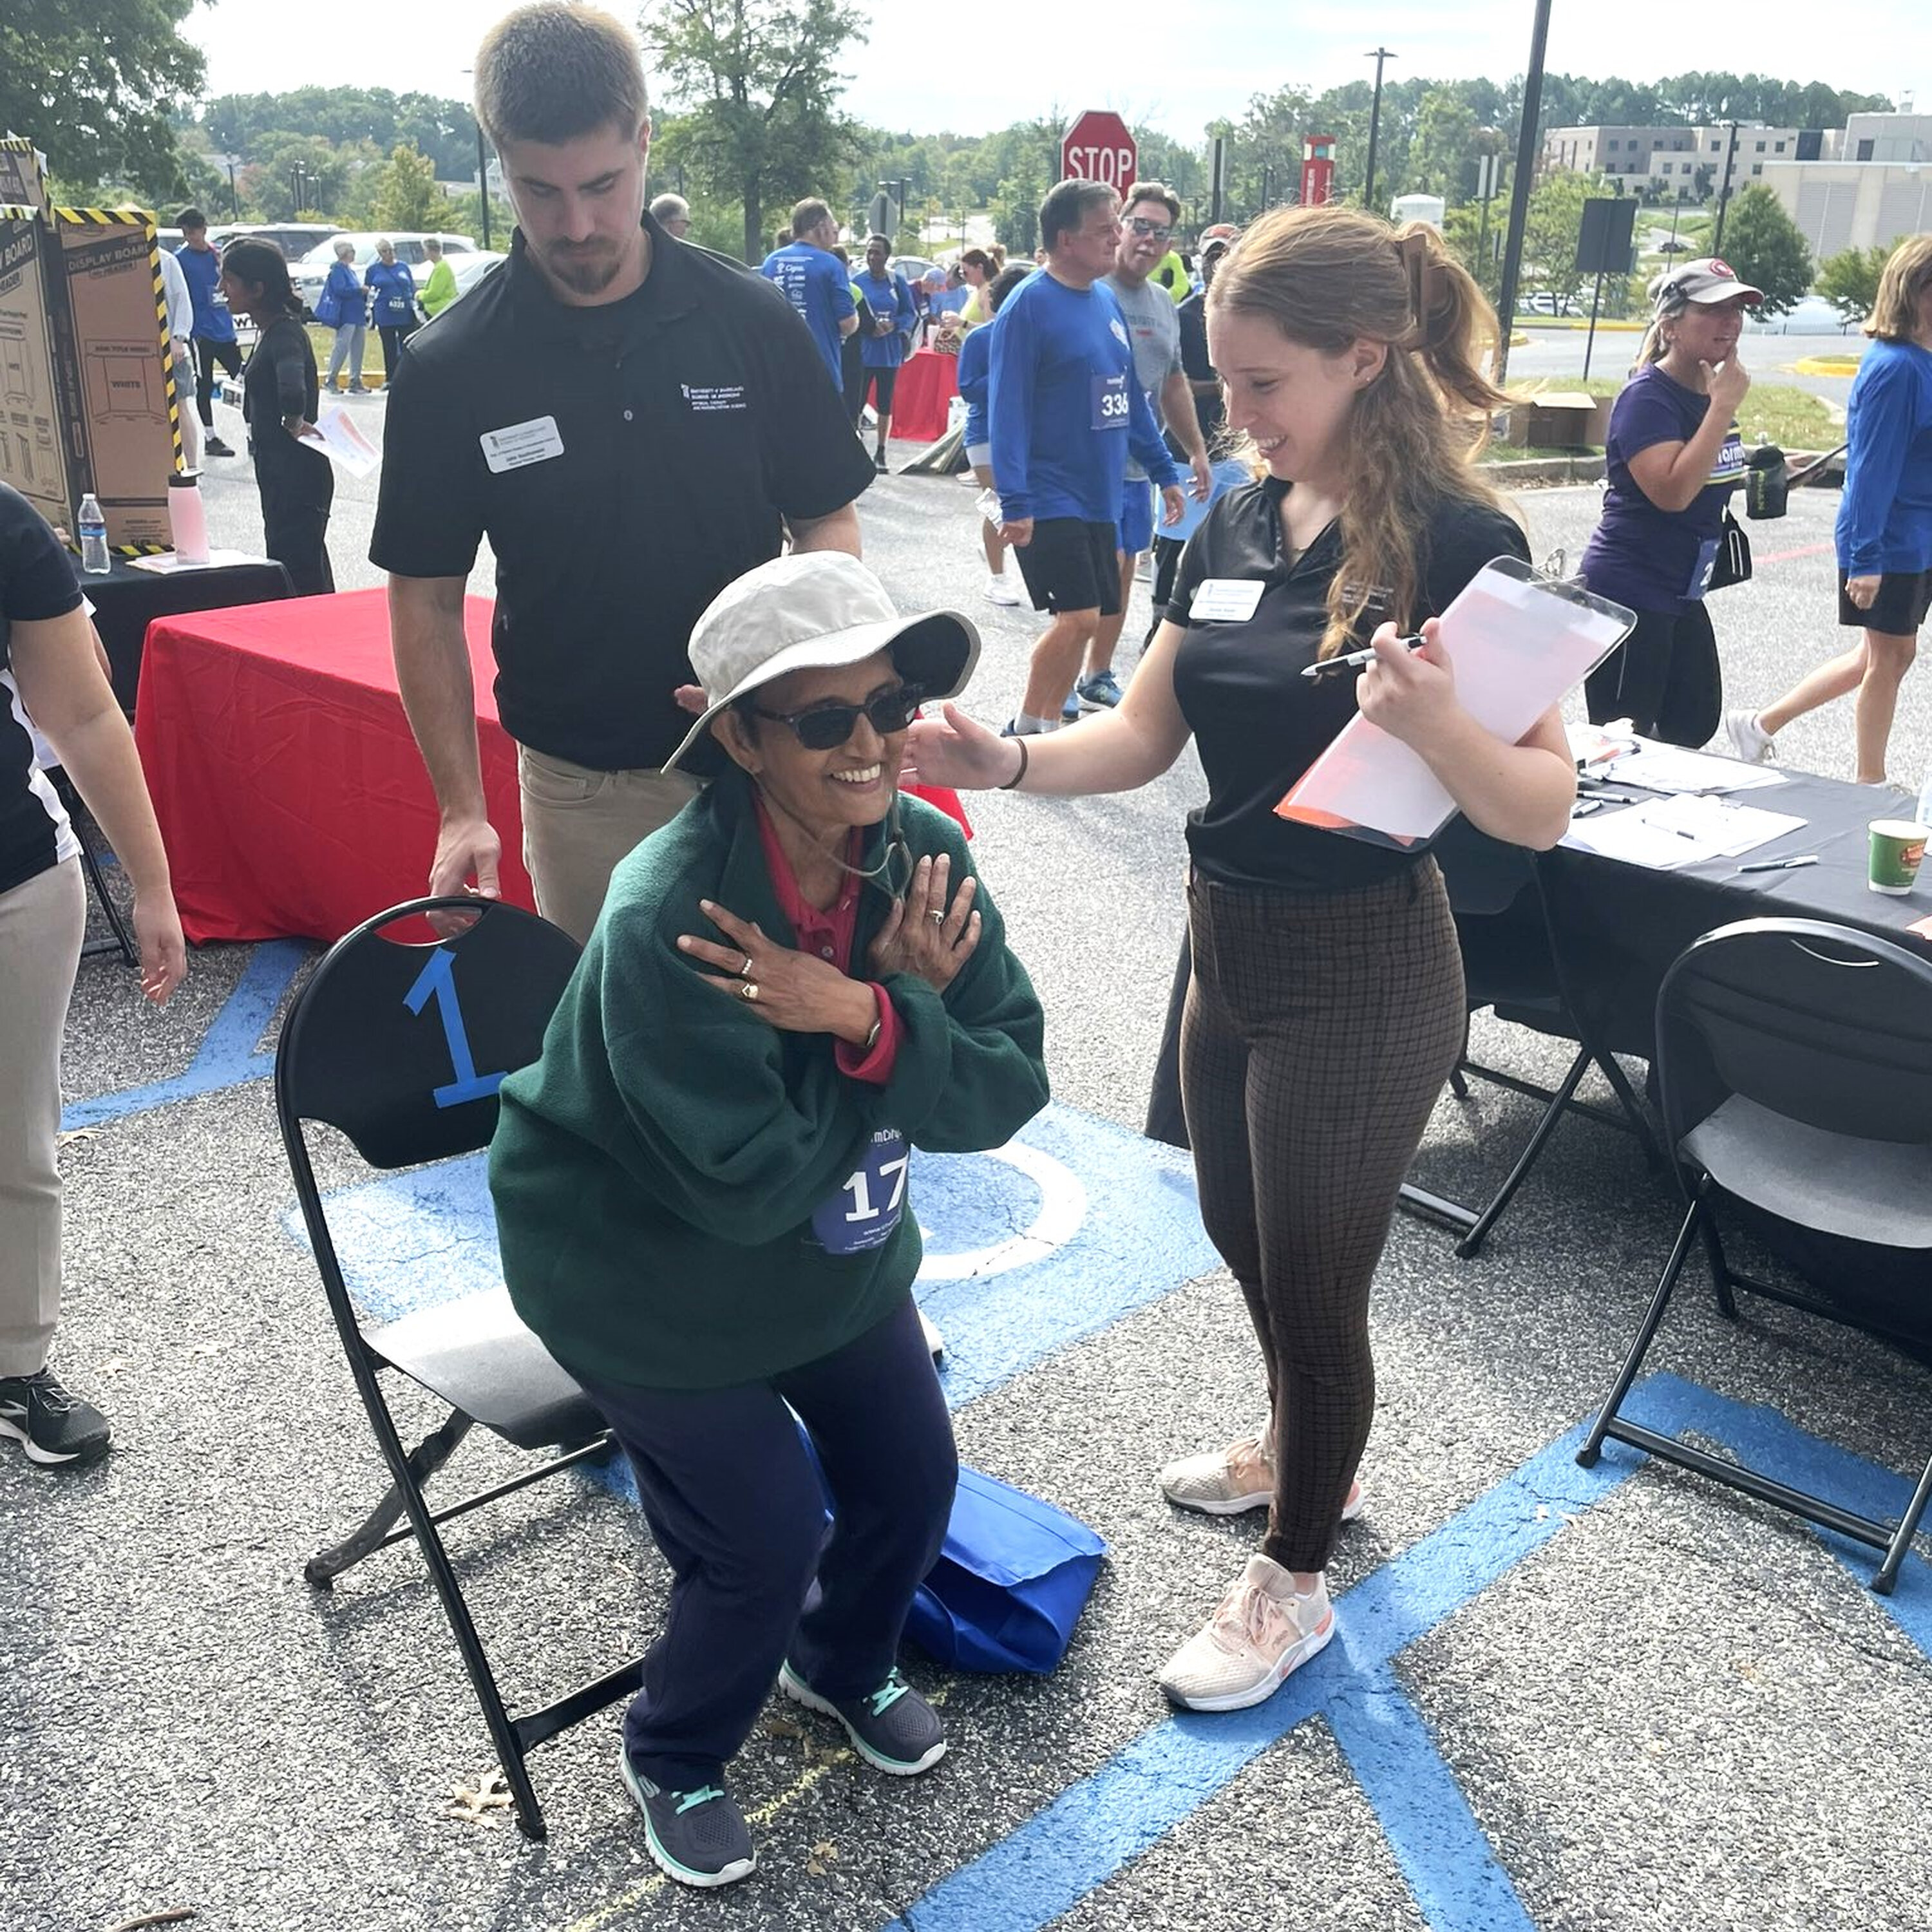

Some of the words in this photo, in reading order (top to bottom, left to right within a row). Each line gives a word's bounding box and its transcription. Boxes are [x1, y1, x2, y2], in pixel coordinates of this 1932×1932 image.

[1068, 146, 1133, 187] STOP
[68, 252, 111, 271] DISPLAY
[1102, 393, 1128, 416] 336
[403, 946, 510, 1109] 1
[842, 1151, 909, 1222] 17
